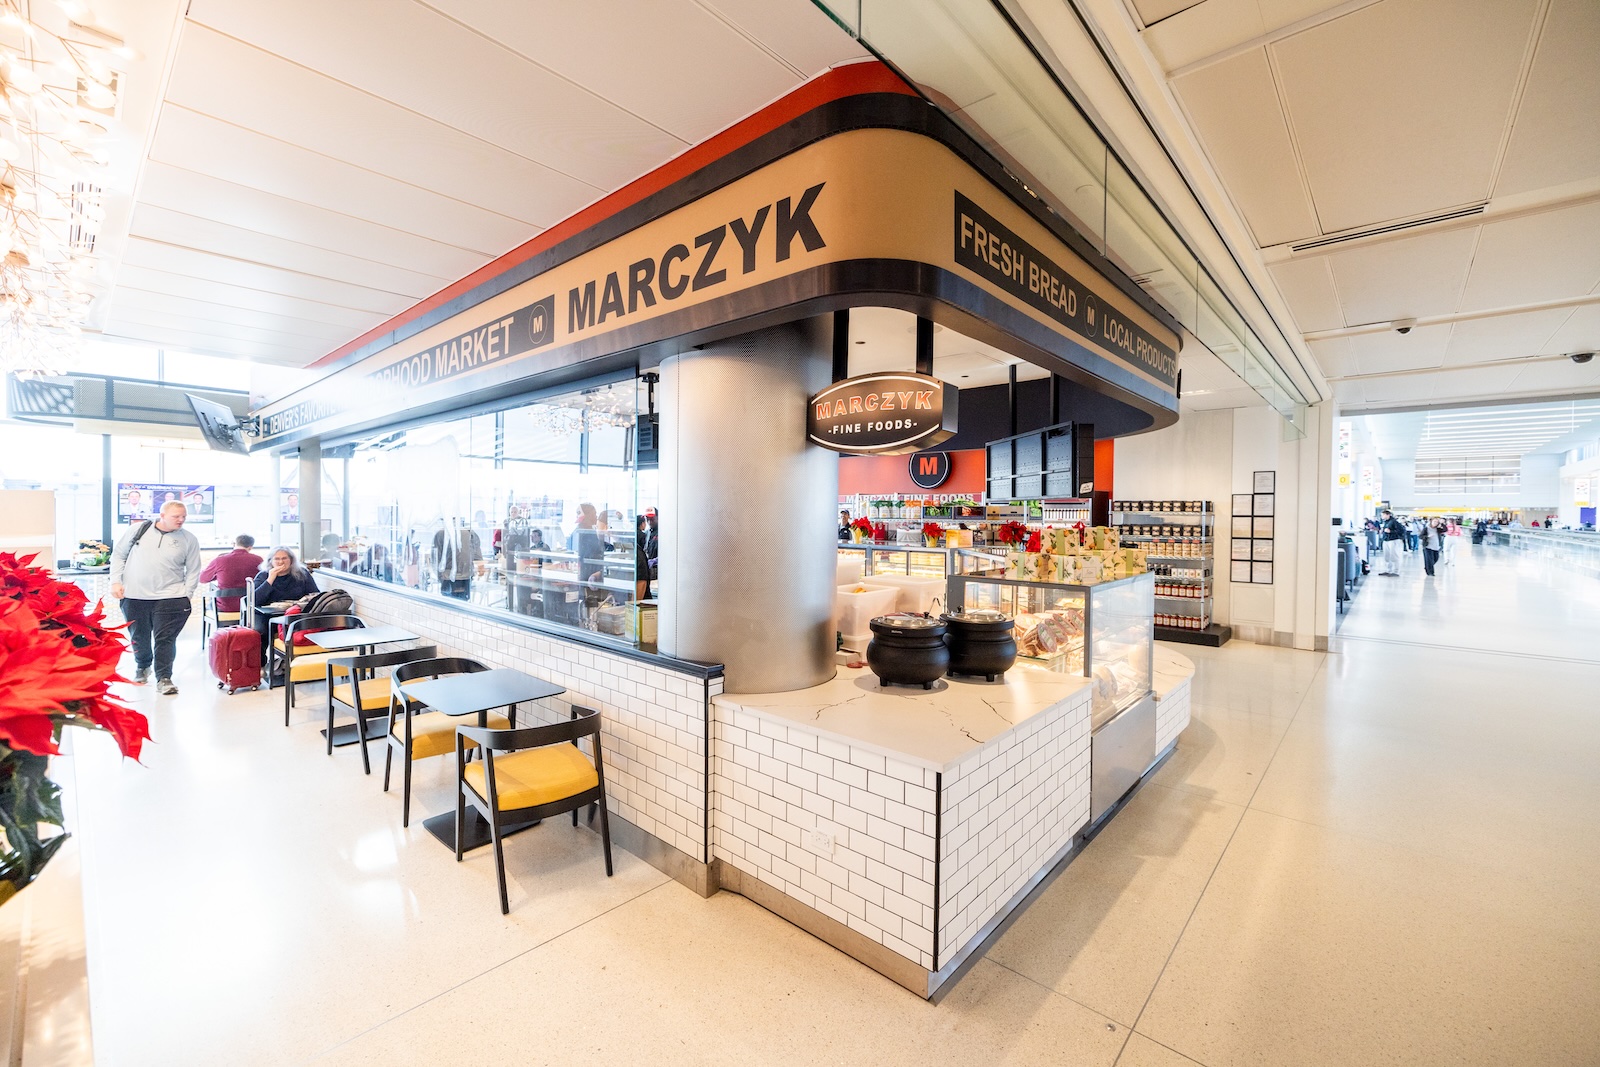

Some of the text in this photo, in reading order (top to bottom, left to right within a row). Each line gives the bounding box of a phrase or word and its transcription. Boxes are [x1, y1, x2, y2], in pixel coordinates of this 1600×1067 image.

[568, 181, 826, 334] MARCZYK
[960, 212, 1176, 379] FRESH BREAD M LOCAL PRODUCTS
[270, 404, 299, 436] DENVER'S
[435, 316, 514, 379] MARKET
[533, 315, 543, 335] M
[816, 390, 933, 420] MARCZYK
[919, 456, 938, 476] M
[933, 493, 974, 503] FOODS
